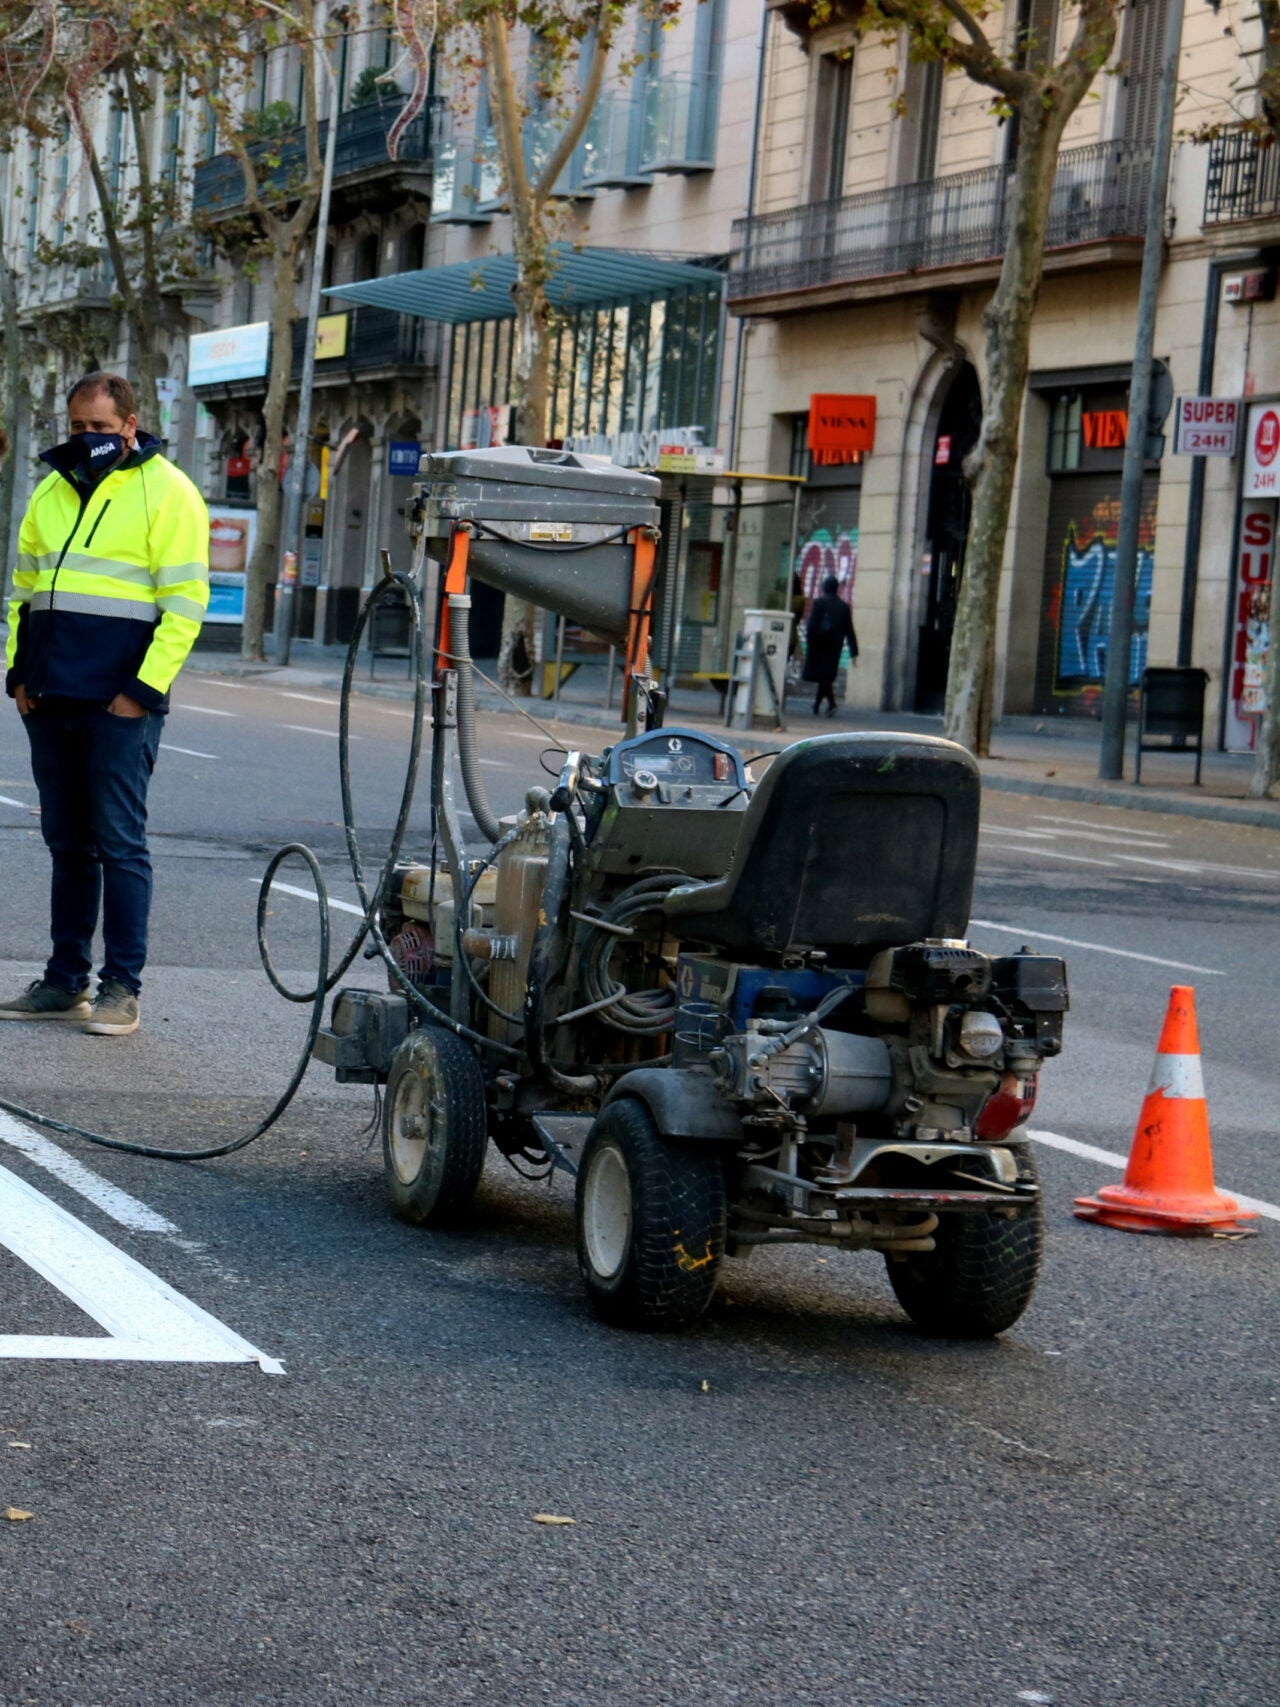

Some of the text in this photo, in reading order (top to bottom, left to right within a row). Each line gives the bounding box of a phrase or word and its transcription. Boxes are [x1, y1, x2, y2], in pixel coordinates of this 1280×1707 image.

[1183, 401, 1236, 423] SUPER
[820, 416, 867, 429] VIENA
[1082, 410, 1129, 448] VIEN
[1191, 433, 1226, 448] 24H
[1253, 472, 1275, 489] 24H
